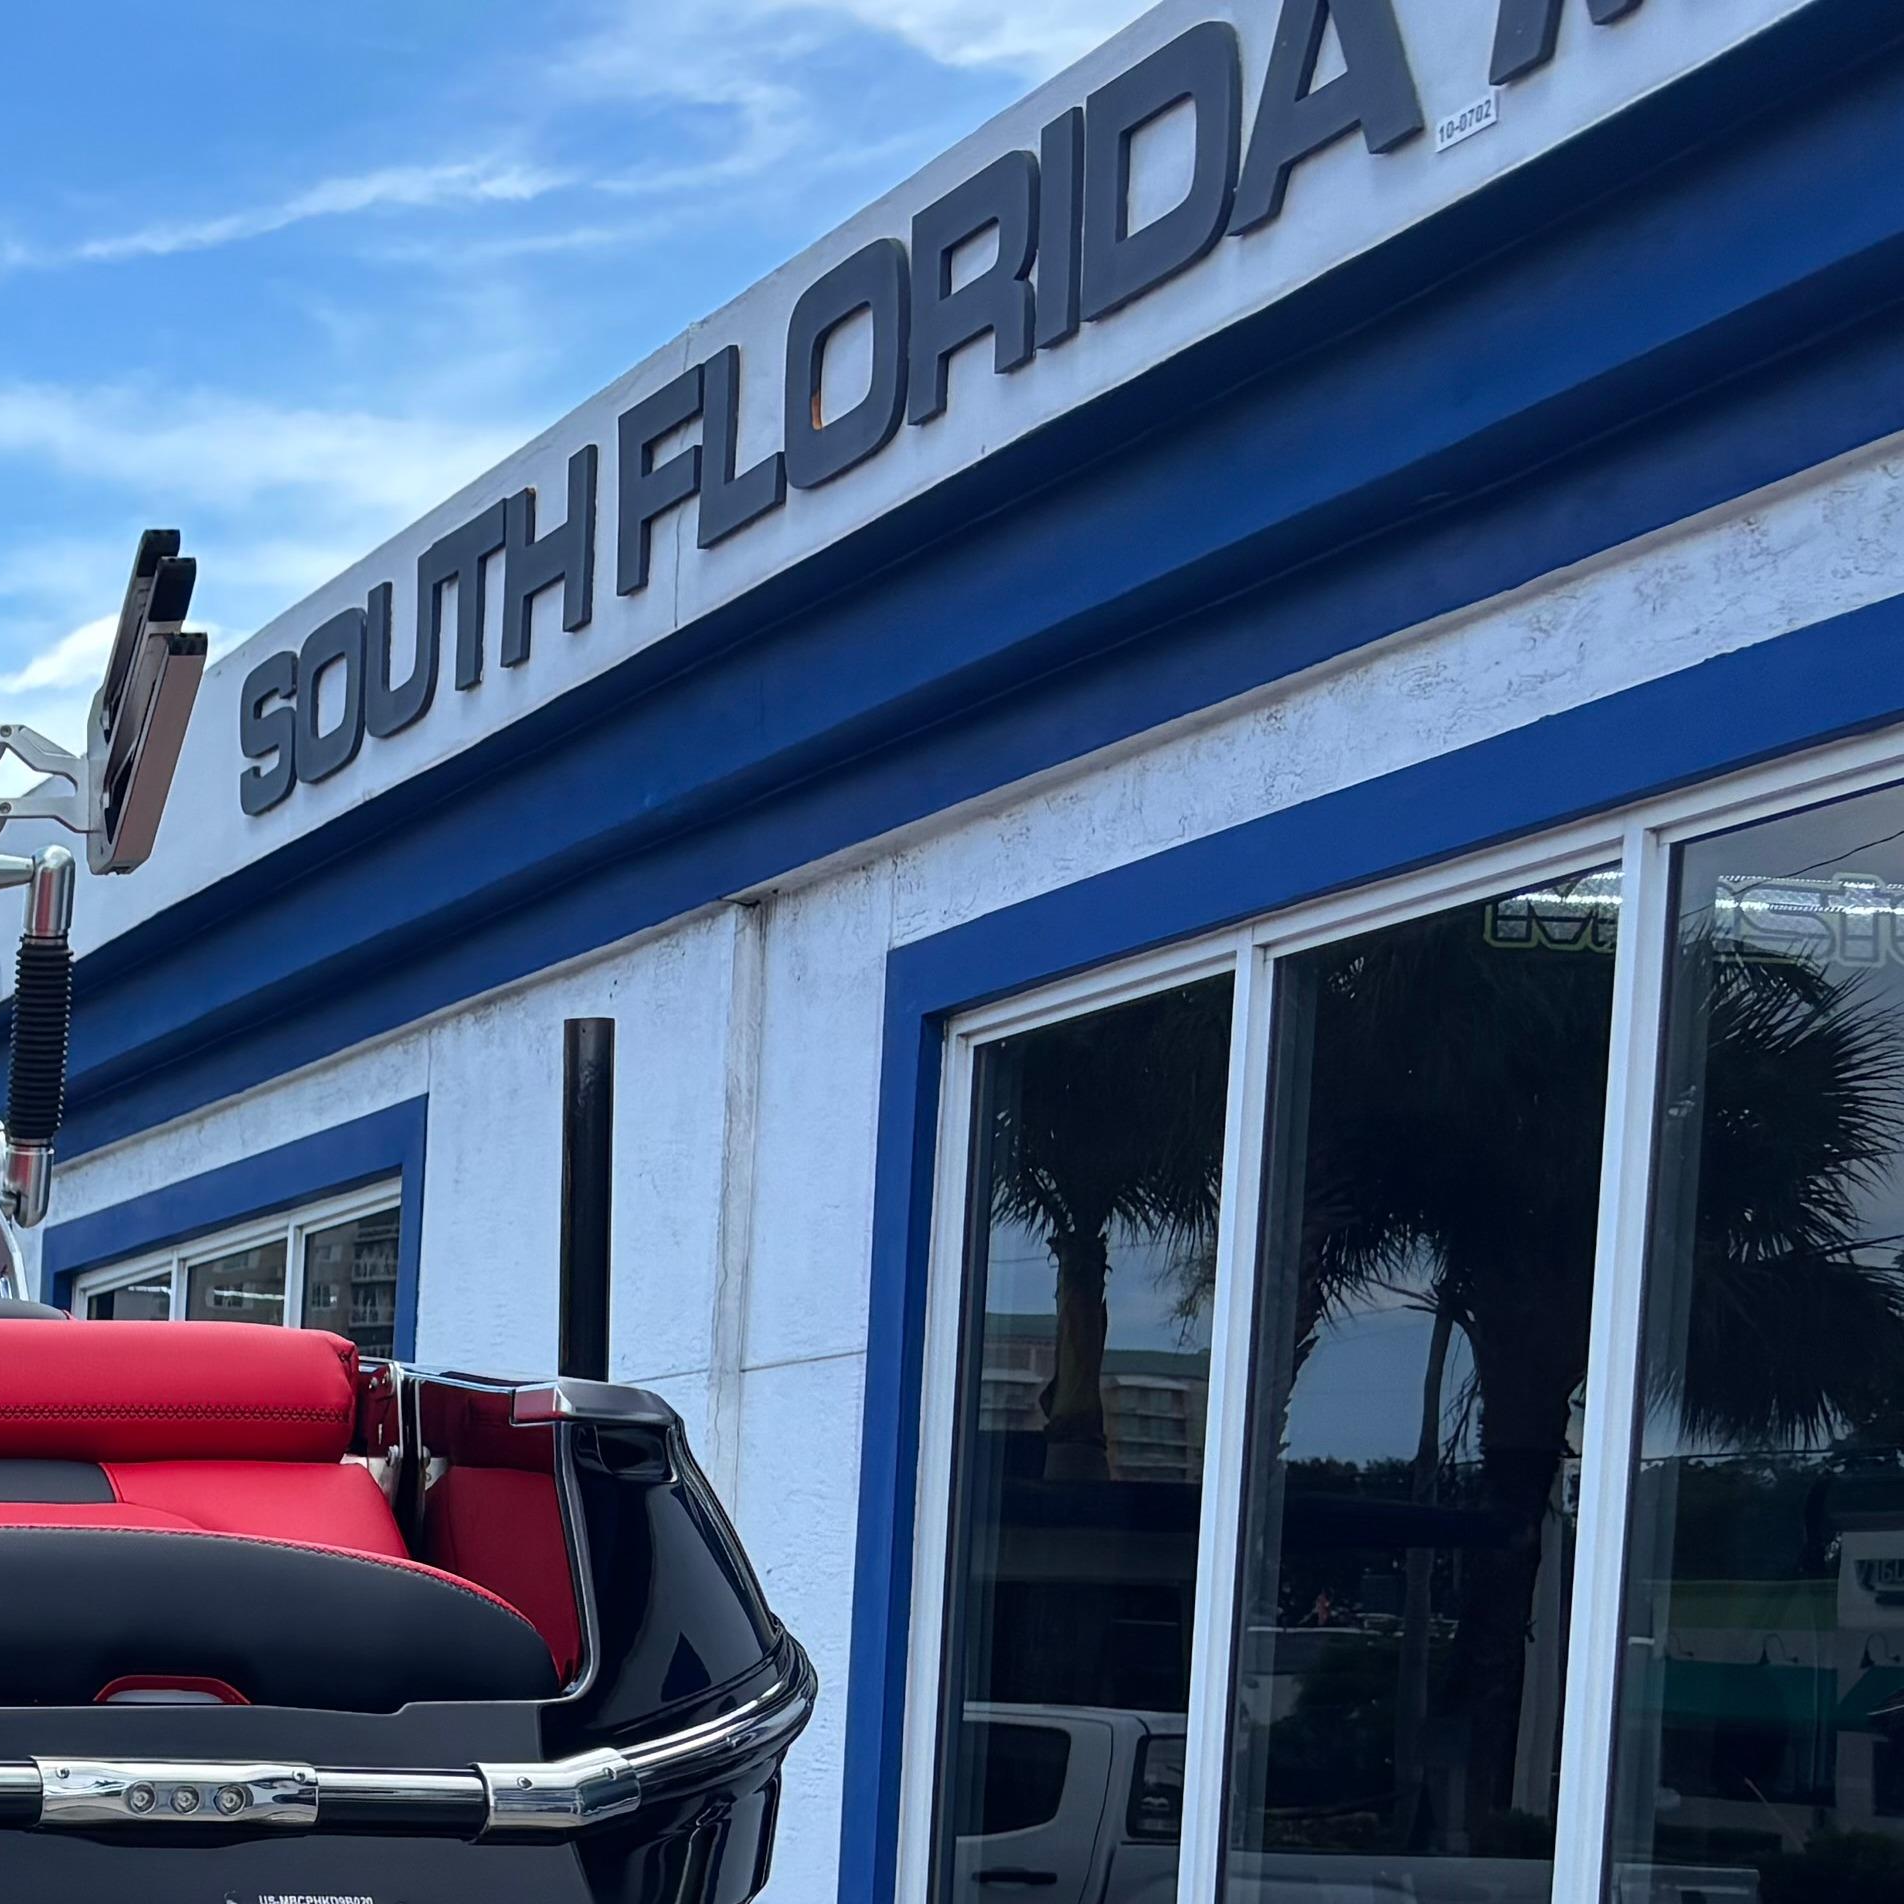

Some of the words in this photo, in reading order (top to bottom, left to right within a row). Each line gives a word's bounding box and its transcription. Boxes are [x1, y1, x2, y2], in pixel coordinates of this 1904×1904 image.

[1438, 98, 1492, 143] 10-0702
[240, 443, 598, 816] SOUTH
[617, 0, 1425, 596] FLORIDA
